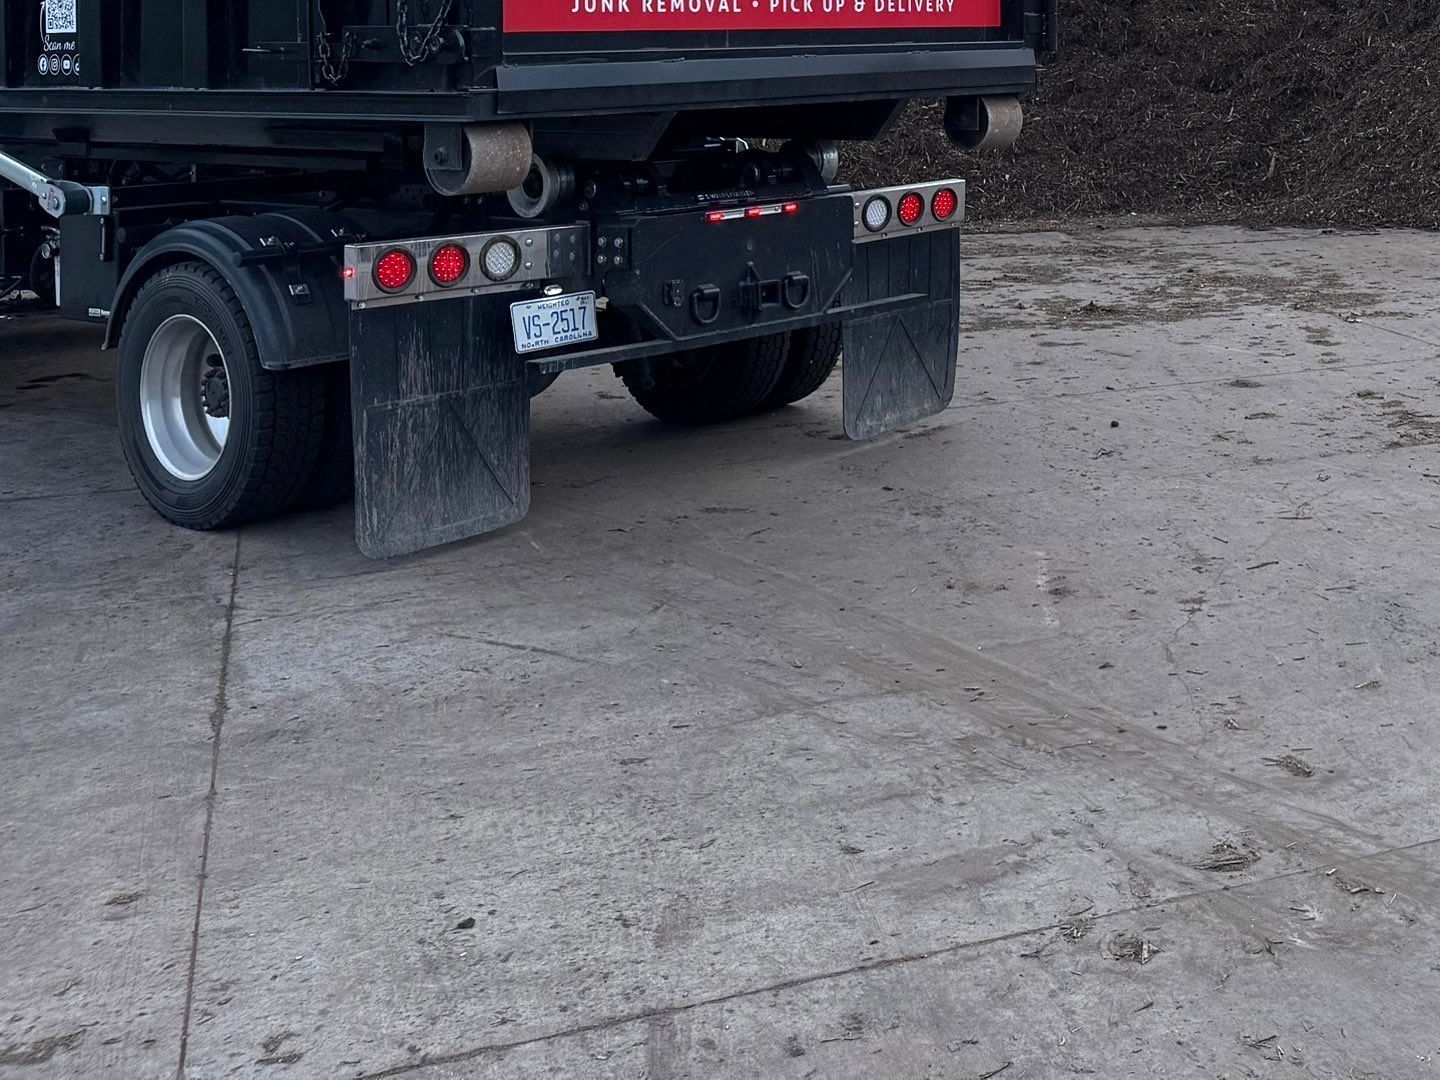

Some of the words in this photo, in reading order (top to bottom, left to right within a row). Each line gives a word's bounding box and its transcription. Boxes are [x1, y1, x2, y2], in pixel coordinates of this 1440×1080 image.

[43, 34, 62, 51] Scan
[64, 41, 76, 51] me
[522, 306, 587, 340] VS-2517
